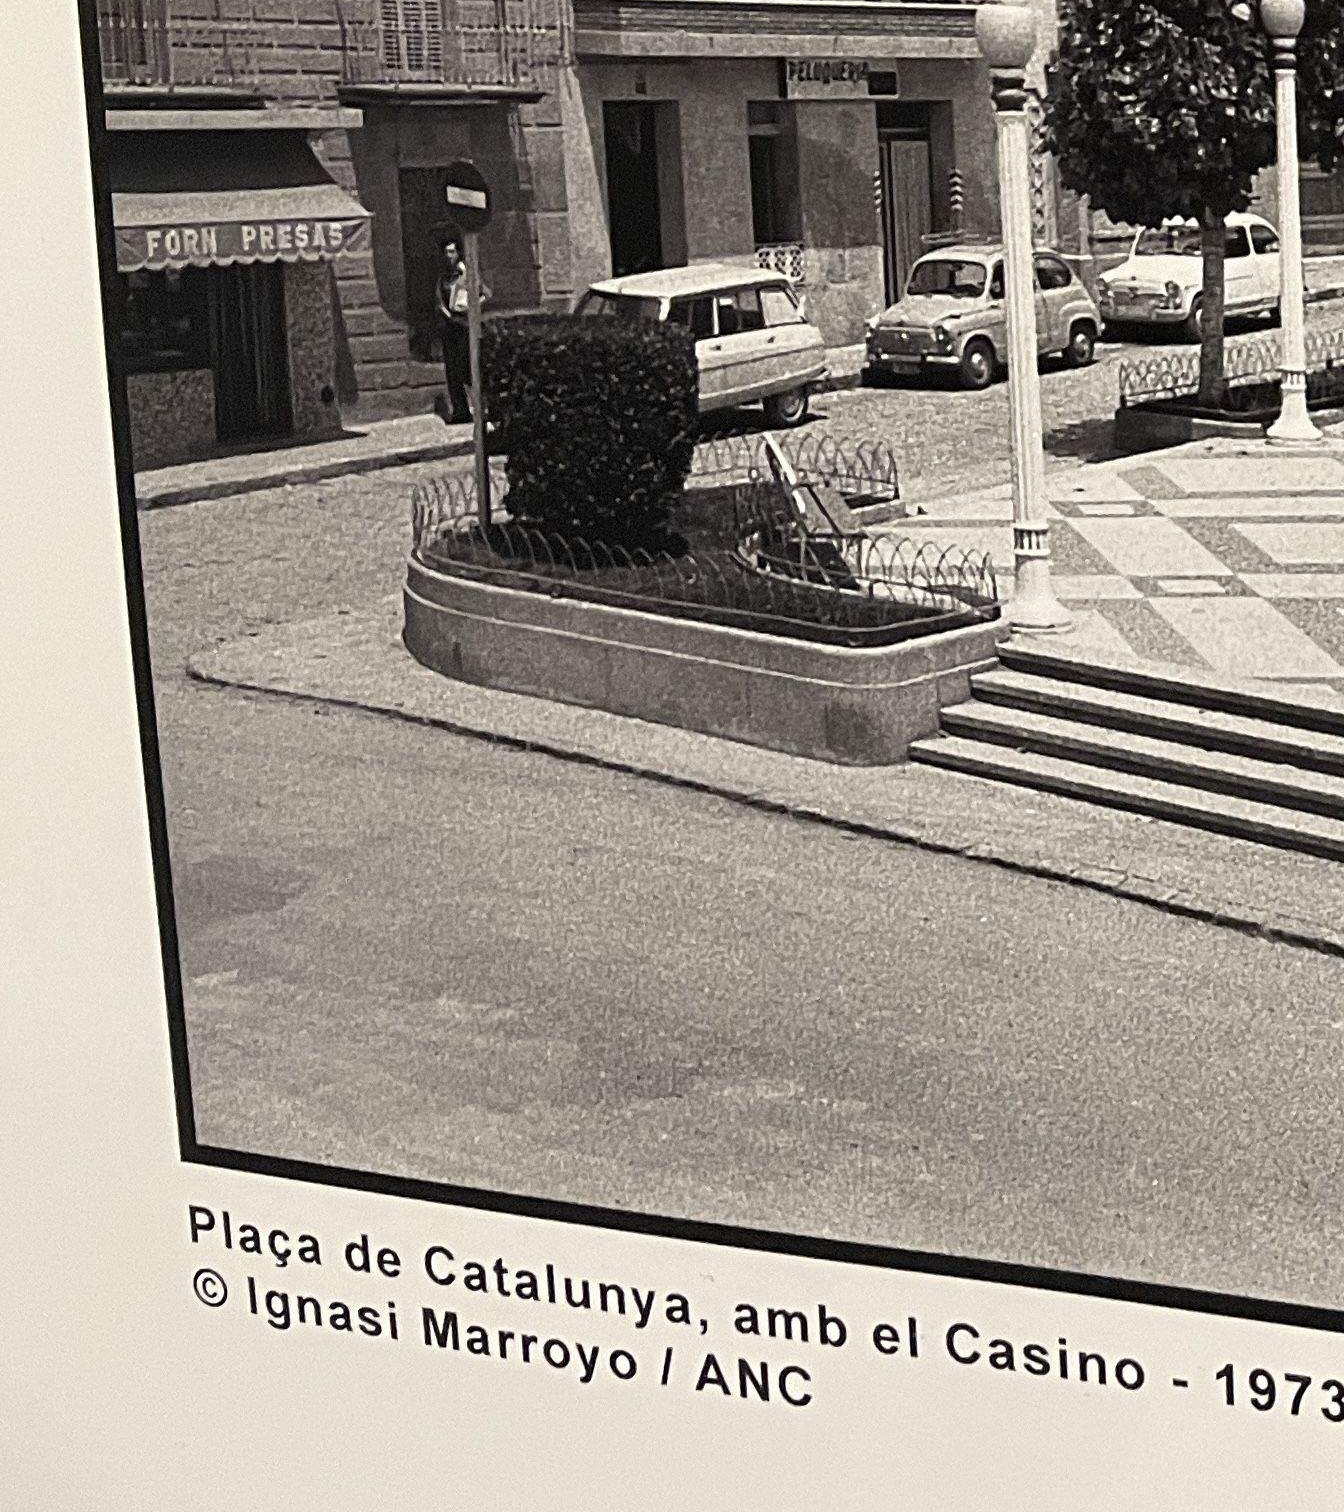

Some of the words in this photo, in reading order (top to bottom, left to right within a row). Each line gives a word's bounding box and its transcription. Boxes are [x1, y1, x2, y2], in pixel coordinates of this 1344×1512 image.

[145, 225, 218, 258] FORN
[240, 222, 344, 252] PRESAS
[188, 1204, 324, 1267] Plaça
[344, 1233, 401, 1278] de
[424, 1245, 708, 1336] Catalunya,
[734, 1303, 848, 1349] amb
[872, 1316, 919, 1358] el
[945, 1322, 1145, 1392] Casino
[1172, 1378, 1189, 1388] -
[193, 1268, 228, 1308] ©
[247, 1276, 399, 1340] Ignasi
[421, 1307, 638, 1384] Marroyo
[660, 1346, 673, 1386] /
[695, 1353, 812, 1417] ANC
